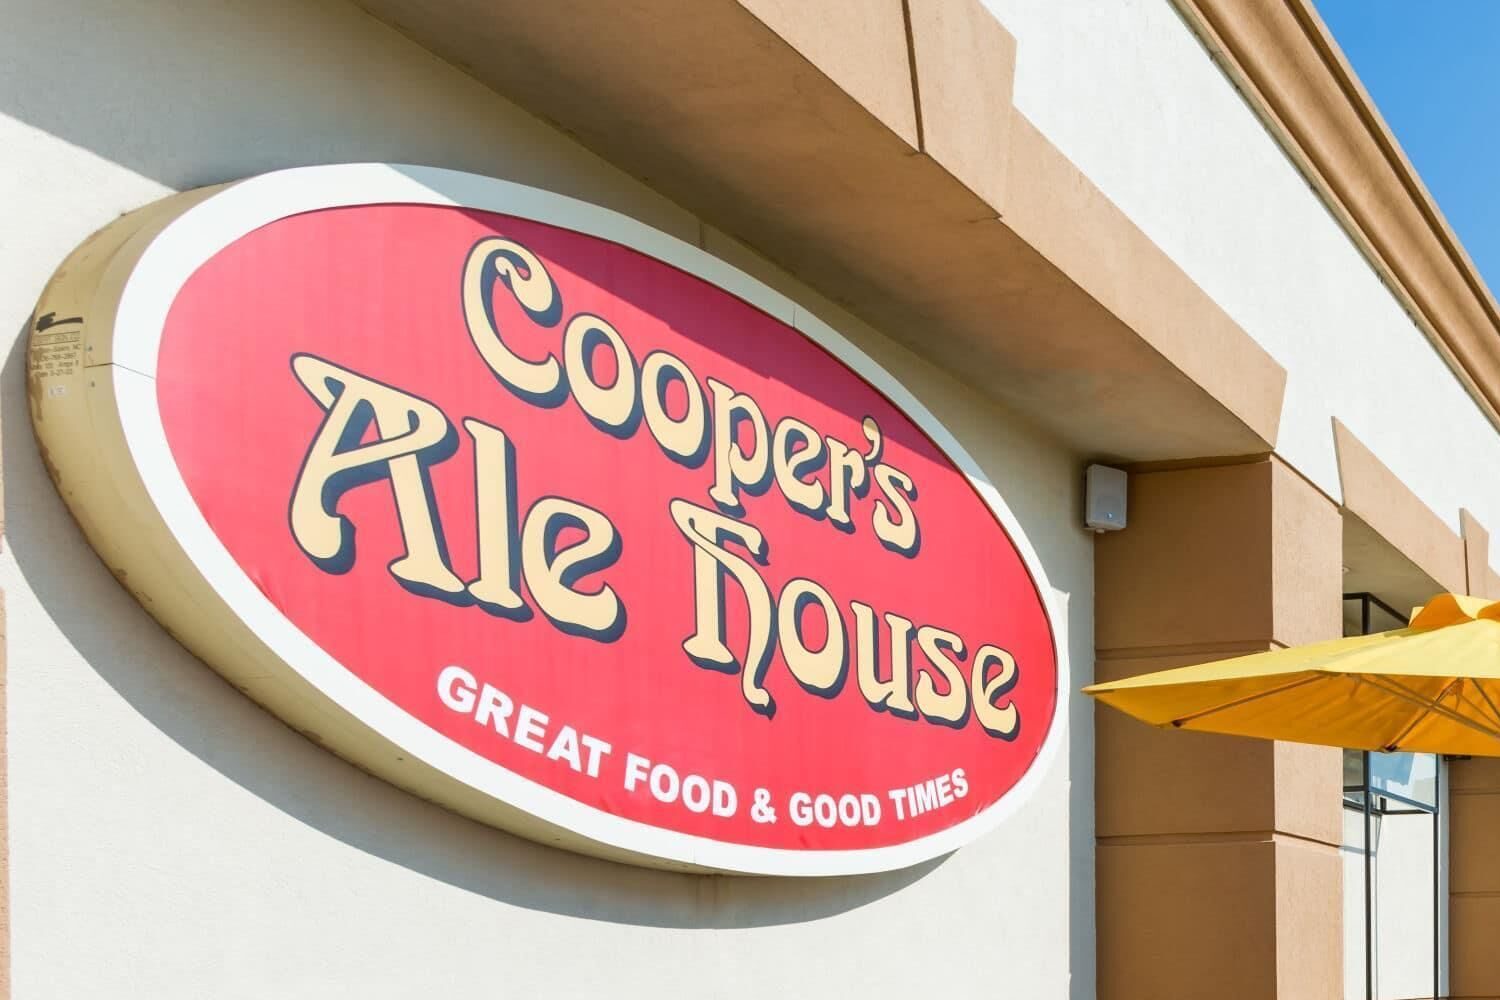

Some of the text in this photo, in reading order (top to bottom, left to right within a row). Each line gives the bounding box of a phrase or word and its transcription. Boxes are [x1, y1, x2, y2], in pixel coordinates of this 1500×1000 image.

[288, 352, 627, 644] Ale
[460, 235, 921, 557] Cooper's
[436, 665, 970, 828] GREAT FOOD & GOOD TIMES
